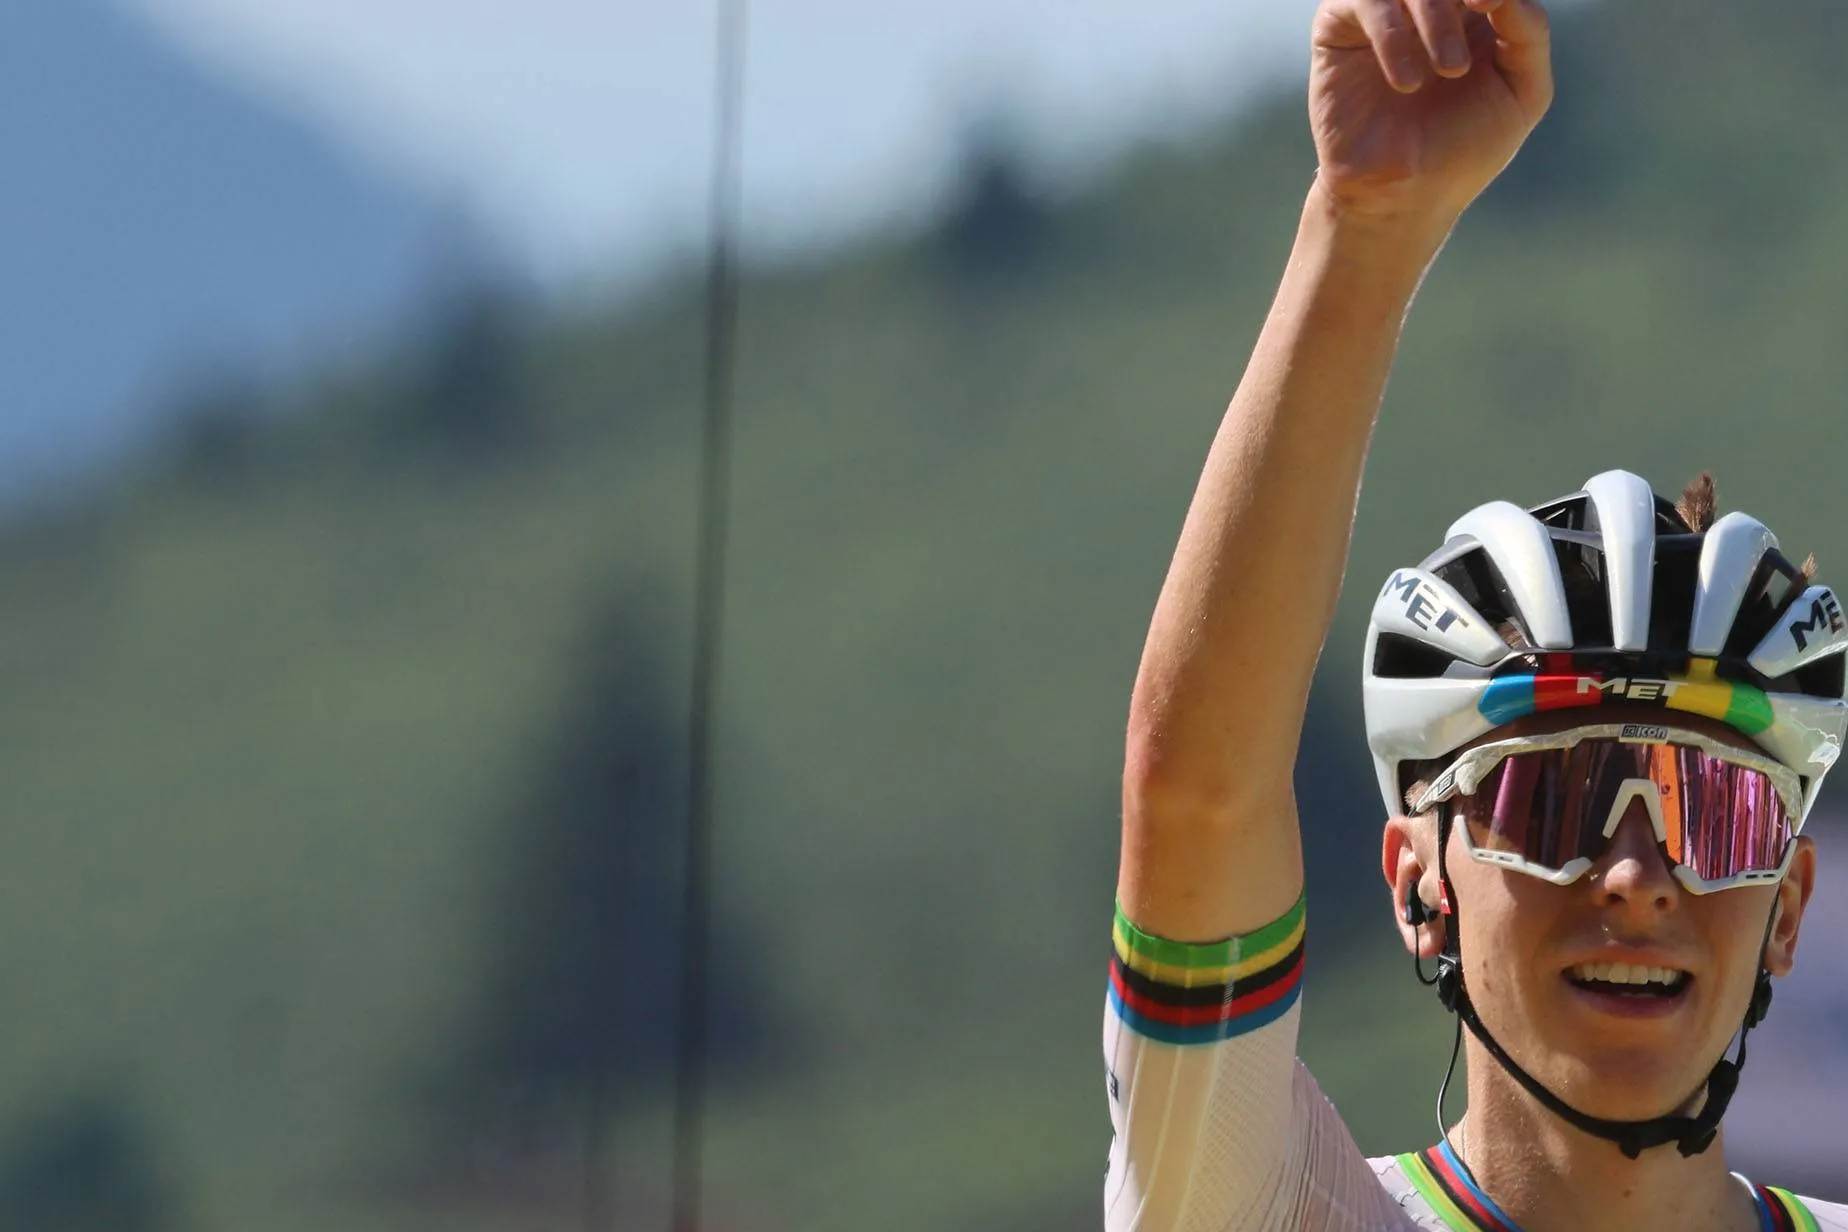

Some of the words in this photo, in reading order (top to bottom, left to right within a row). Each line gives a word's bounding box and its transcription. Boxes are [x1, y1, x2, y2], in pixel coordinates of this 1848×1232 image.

[1383, 572, 1470, 633] MET
[1789, 589, 1845, 653] ME
[1576, 676, 1690, 700] MET
